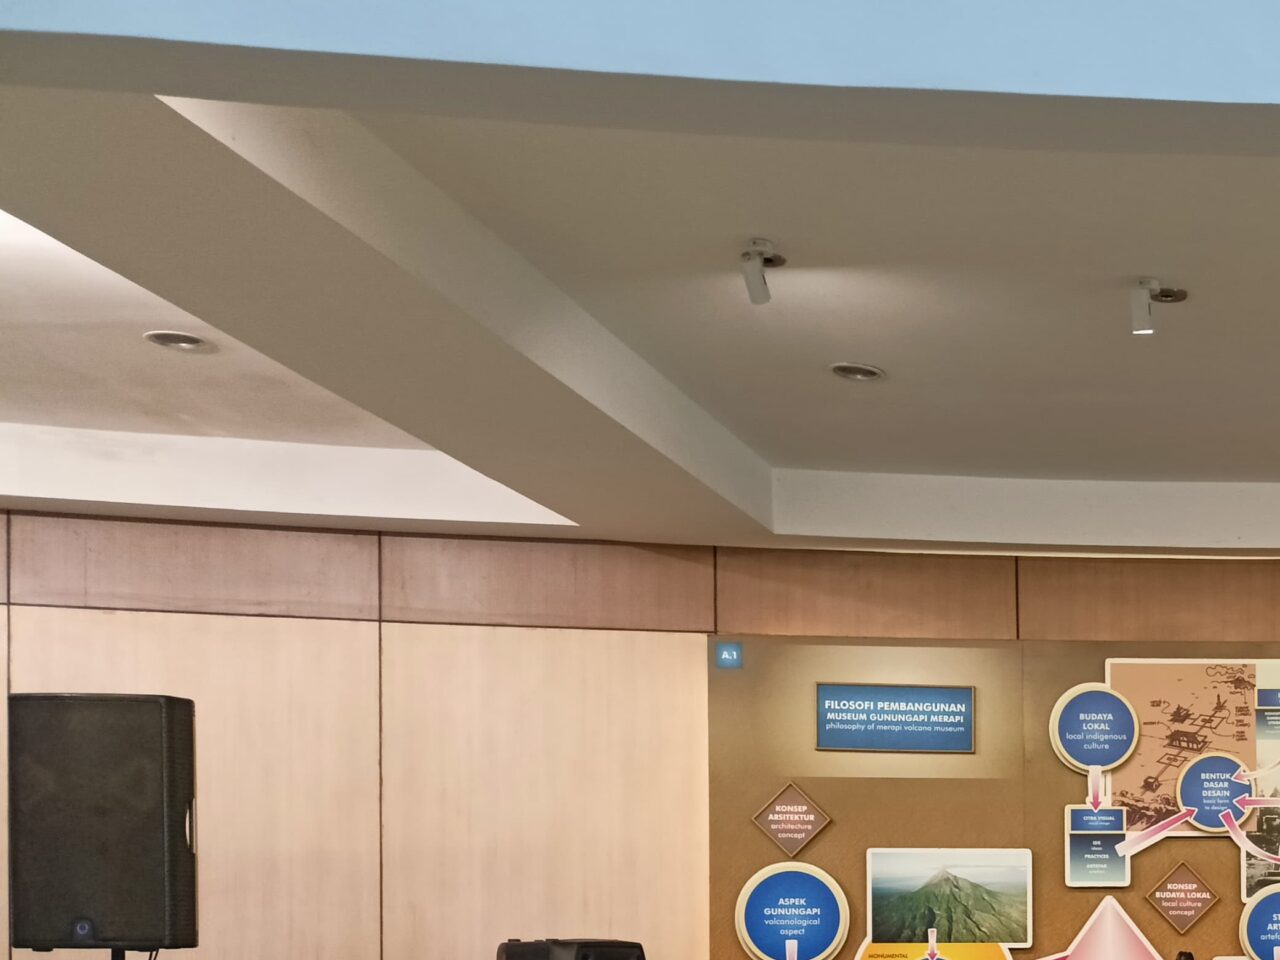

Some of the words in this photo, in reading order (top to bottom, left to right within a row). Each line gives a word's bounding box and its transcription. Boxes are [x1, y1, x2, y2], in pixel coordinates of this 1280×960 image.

[721, 651, 737, 660] A.1
[824, 700, 874, 711] FILOSOFI
[877, 701, 966, 713] PEMBANGUNAN
[826, 712, 867, 721] MUSEUM
[869, 713, 928, 722] GUNUNGAPI
[930, 715, 964, 723] MERAPI
[1079, 713, 1113, 721] BUDAYA
[825, 722, 865, 732] philosophy
[867, 722, 875, 731] of
[876, 723, 902, 733] merapi
[904, 724, 932, 732] volcano
[933, 725, 965, 733] museum
[1066, 732, 1084, 740] local
[1085, 732, 1127, 742] indigenous
[1083, 742, 1110, 750] culture
[775, 805, 807, 813] KONSEP
[767, 813, 815, 821] ARSITEKTUR
[770, 822, 813, 830] architecture
[777, 831, 806, 839] concept
[778, 898, 807, 906] ASPEK
[1179, 900, 1202, 908] culture
[763, 908, 821, 916] GUNUNGAPI
[764, 918, 821, 927] volcanological
[779, 928, 805, 936] aspect
